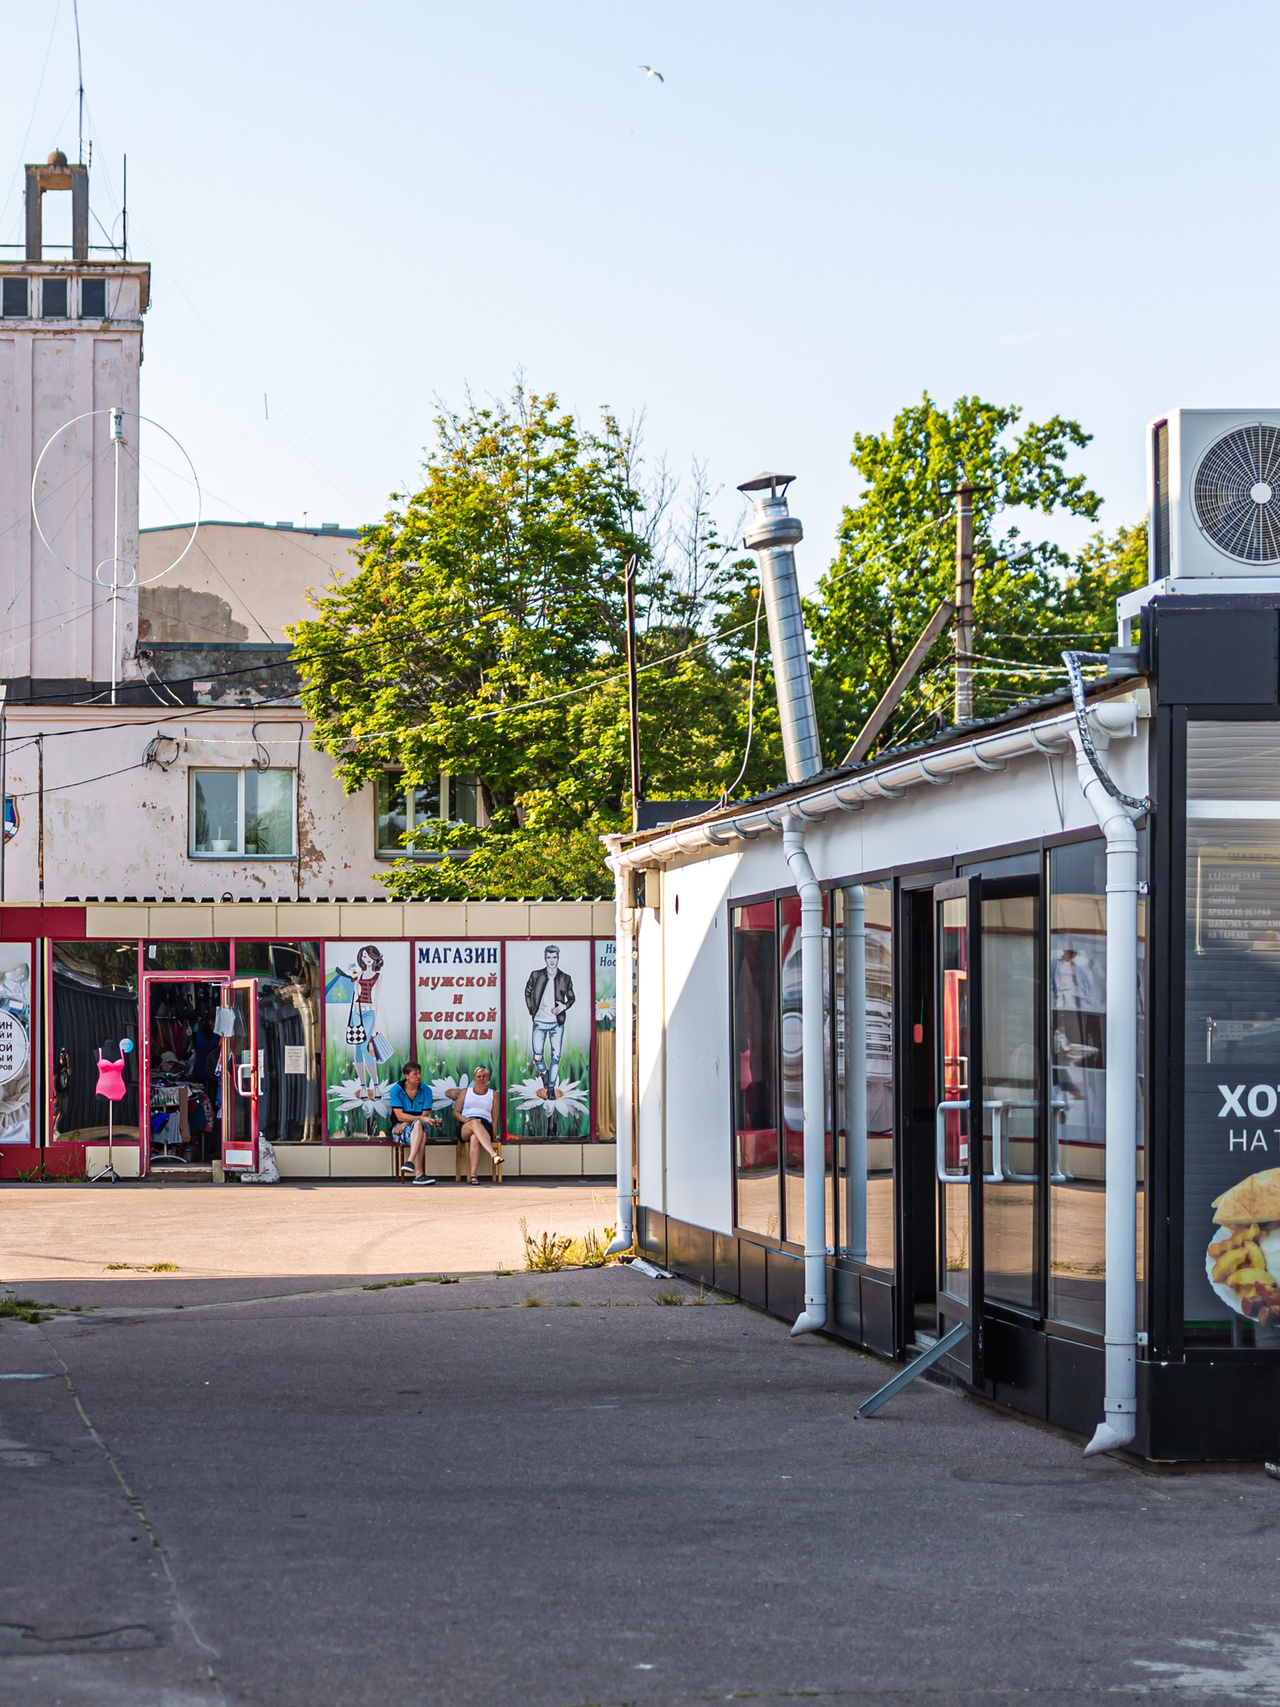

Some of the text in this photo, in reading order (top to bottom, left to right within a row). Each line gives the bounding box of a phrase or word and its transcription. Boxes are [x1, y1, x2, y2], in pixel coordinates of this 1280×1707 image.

[417, 947, 498, 964] МАГАЗИН
[418, 972, 498, 991] мужской
[418, 1007, 497, 1022] женской
[422, 1028, 494, 1041] одежды
[6, 1054, 13, 1062] И
[1217, 1084, 1280, 1118] ХО
[1229, 1129, 1268, 1152] НА
